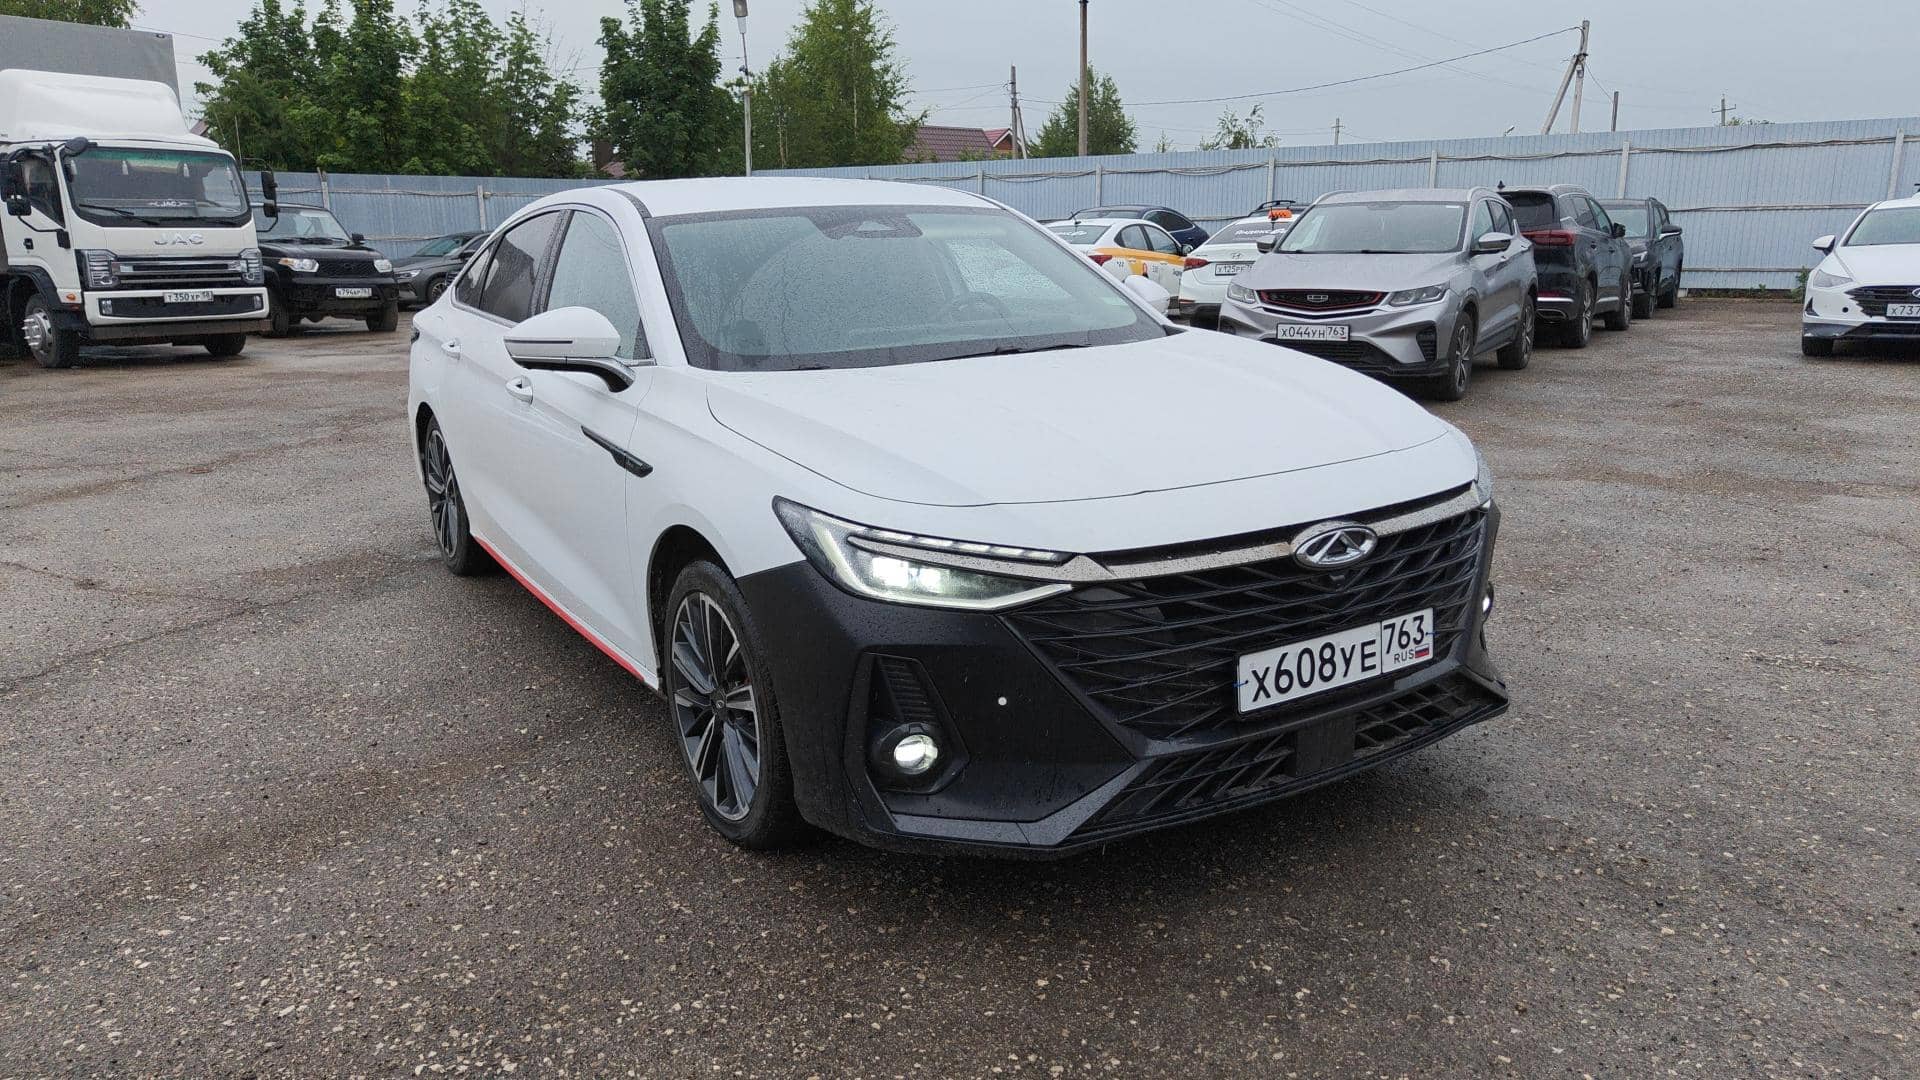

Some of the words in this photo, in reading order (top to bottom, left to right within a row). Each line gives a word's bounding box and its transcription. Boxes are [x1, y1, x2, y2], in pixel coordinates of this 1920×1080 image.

[153, 231, 204, 247] JAC
[1327, 326, 1345, 336] 763
[1251, 639, 1377, 703] Х608УЕ
[1383, 614, 1425, 655] 763
[1394, 651, 1415, 664] RUS
